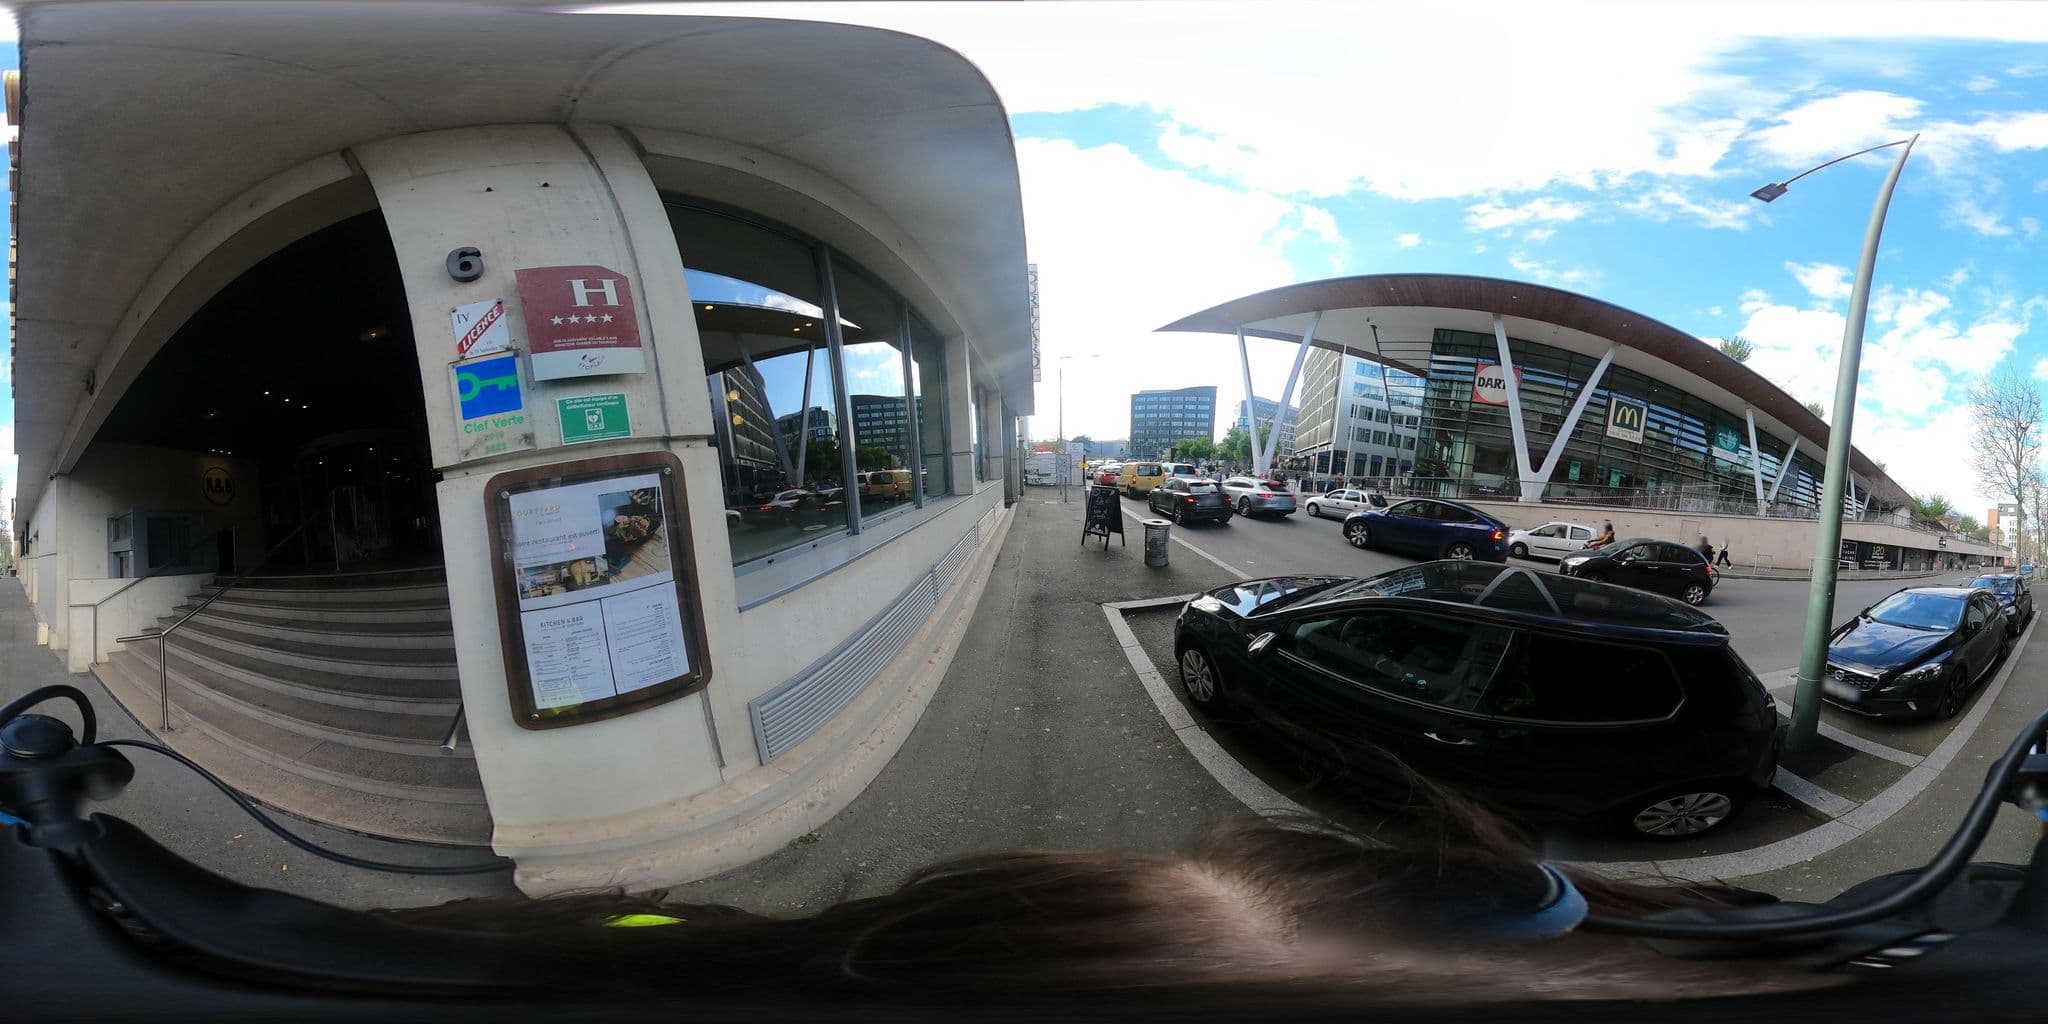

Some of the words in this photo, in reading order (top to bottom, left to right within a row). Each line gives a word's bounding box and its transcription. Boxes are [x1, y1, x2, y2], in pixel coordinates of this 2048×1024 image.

[446, 247, 484, 283] 6
[566, 279, 624, 307] H
[456, 312, 470, 324] IV
[462, 305, 501, 350] LICENCE
[1477, 376, 1506, 390] DART
[464, 419, 489, 434] Clef
[491, 415, 525, 429] Verte
[532, 532, 567, 546] restaurant
[540, 619, 566, 628] KITCHEN
[571, 615, 584, 624] BAR
